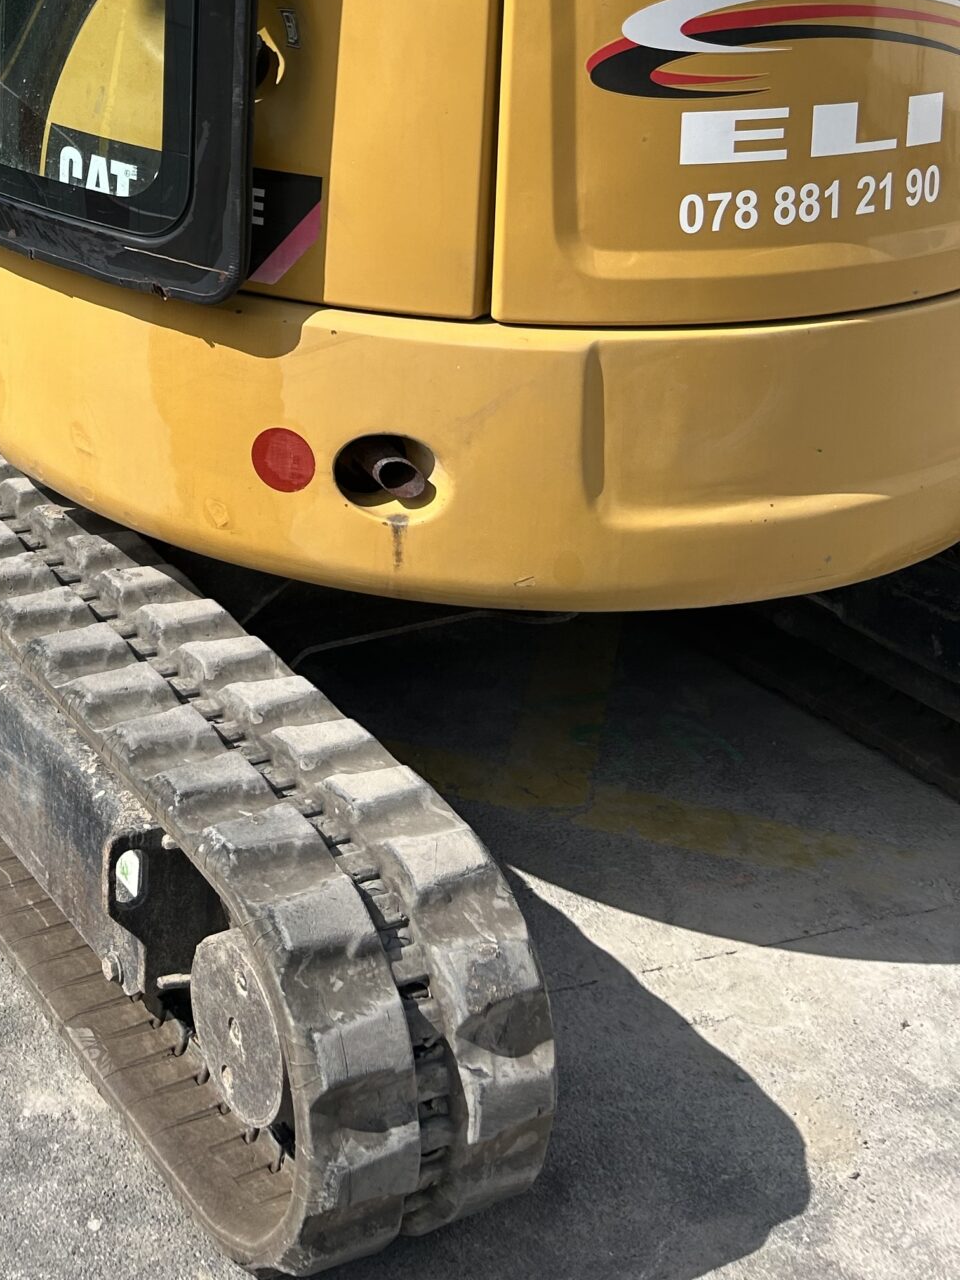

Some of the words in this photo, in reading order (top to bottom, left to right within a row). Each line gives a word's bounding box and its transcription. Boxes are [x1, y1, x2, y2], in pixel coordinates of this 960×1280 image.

[680, 92, 944, 165] ELI
[679, 189, 759, 234] 078
[773, 180, 840, 225] 881
[855, 172, 892, 215] 21
[905, 164, 940, 207] 90
